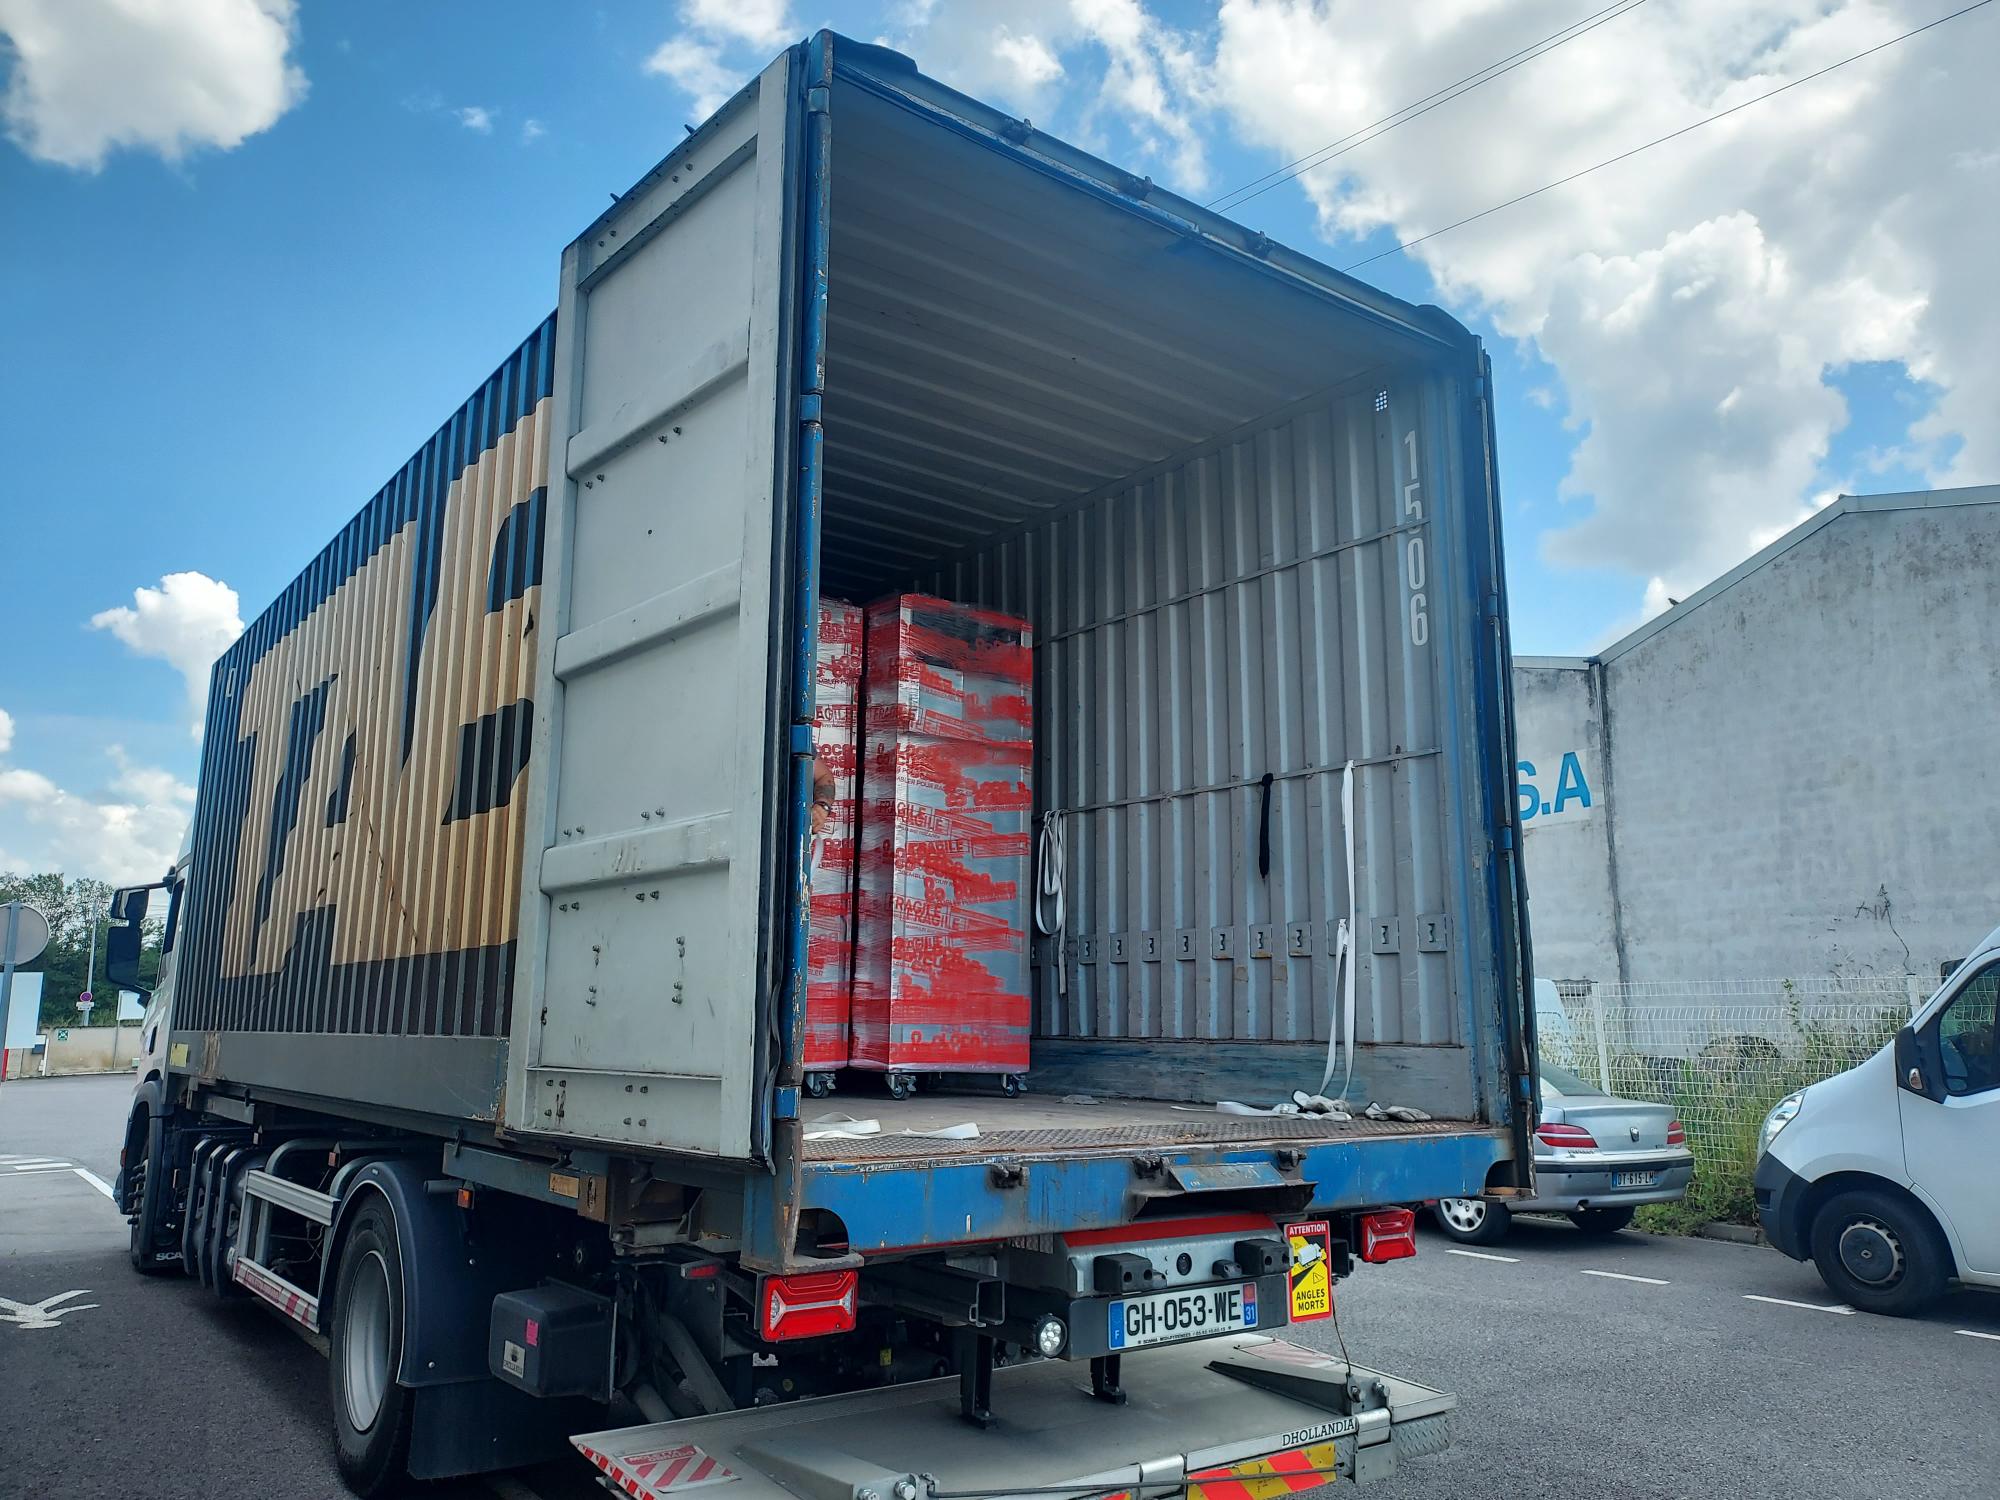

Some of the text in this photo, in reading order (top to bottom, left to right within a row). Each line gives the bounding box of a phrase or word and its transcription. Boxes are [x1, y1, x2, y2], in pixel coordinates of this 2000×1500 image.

[1403, 430, 1429, 646] 1506
[1518, 751, 1592, 821] S.A
[1289, 1223, 1326, 1235] ATTENTION
[1296, 1288, 1325, 1301] ANGLES
[1126, 1289, 1241, 1337] GH-053-WE
[1298, 1299, 1325, 1312] MORTS
[1245, 1306, 1256, 1321] 31
[1114, 1330, 1120, 1340] F
[1282, 1418, 1355, 1447] DHOLLANDIA
